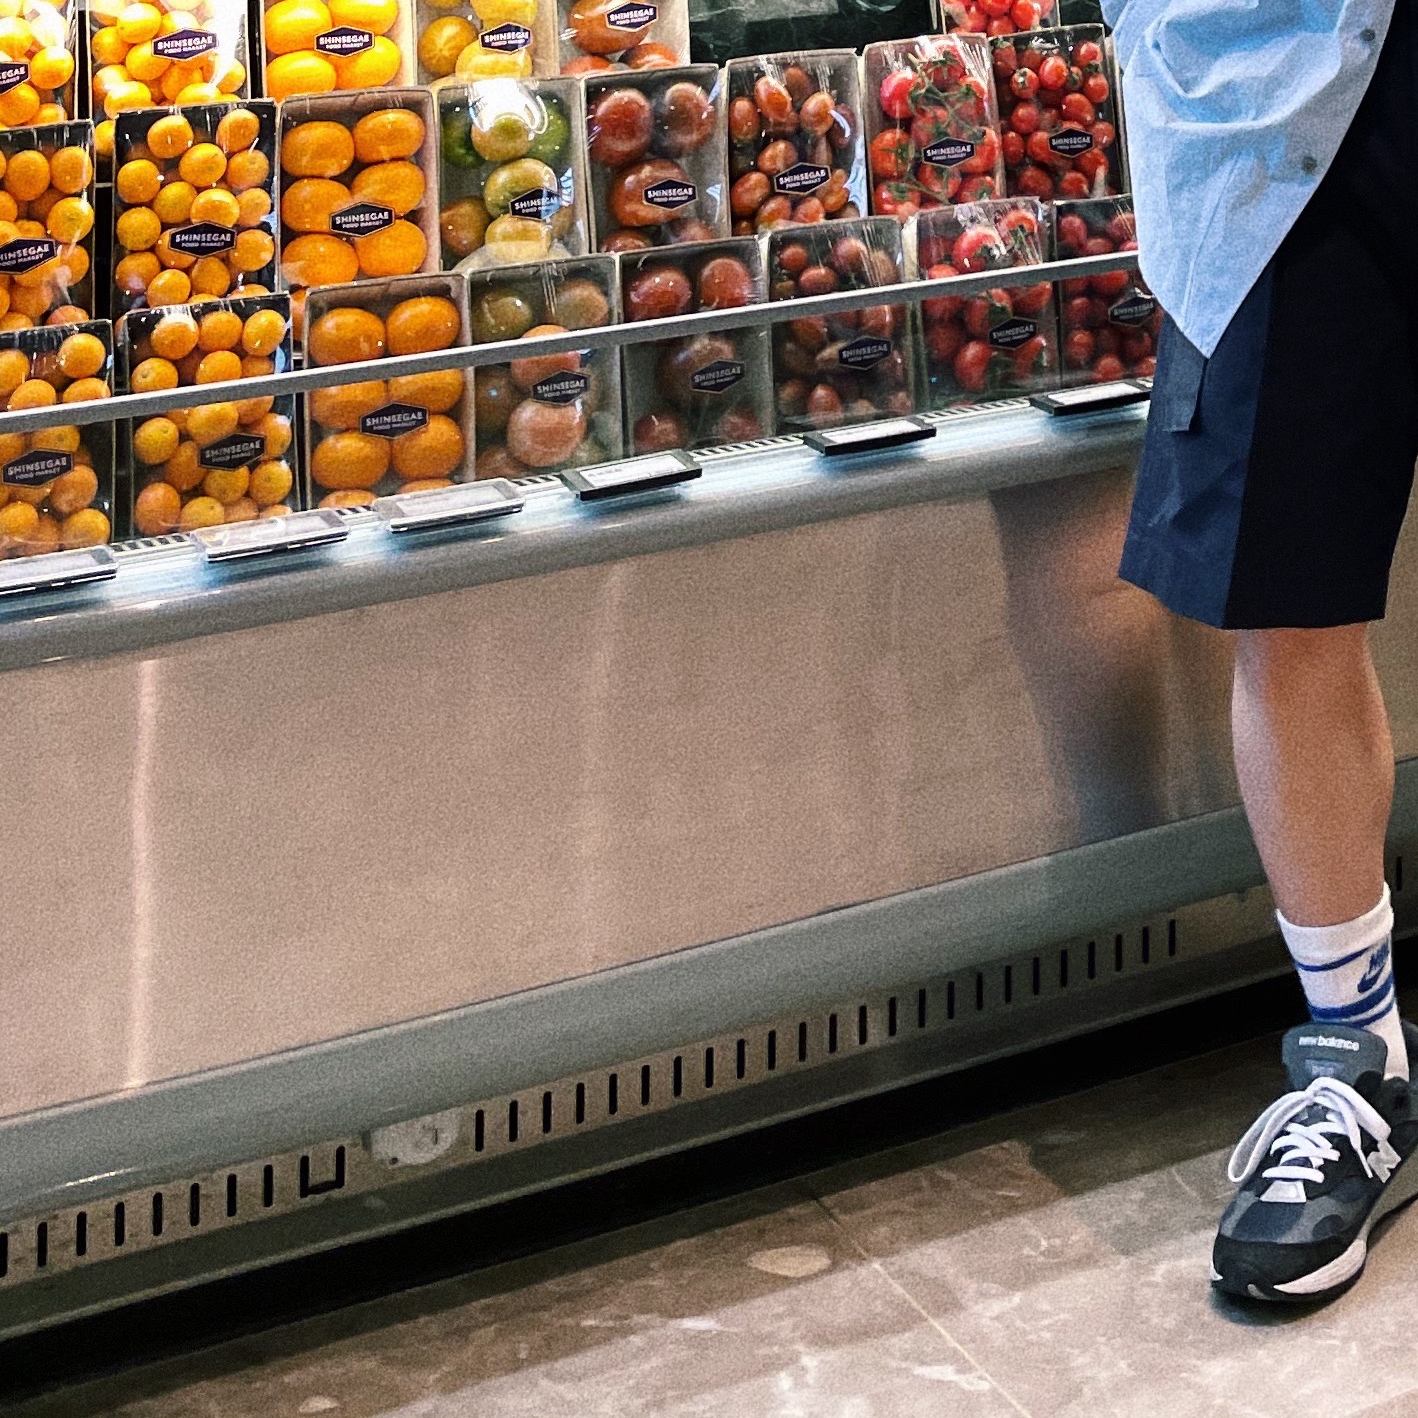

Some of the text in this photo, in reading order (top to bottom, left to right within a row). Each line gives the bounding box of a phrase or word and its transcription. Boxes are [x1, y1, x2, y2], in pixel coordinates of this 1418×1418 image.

[610, 8, 653, 21] SHINSEGAE
[158, 36, 212, 50] SHINSEGAE
[319, 35, 369, 45] SHINSEGAE
[648, 188, 693, 198] SHINSEGAE
[336, 212, 389, 225] SHINSEGAE
[176, 234, 231, 242] SHINSEGAE
[694, 367, 741, 382] SHINSEGAE
[537, 380, 584, 393] SHINSEGAE
[366, 412, 423, 426] SHINSEGAE
[206, 440, 260, 458] SHINSEGAE
[8, 457, 66, 474] SHINSEGAE
[1318, 1035, 1360, 1052] balance
